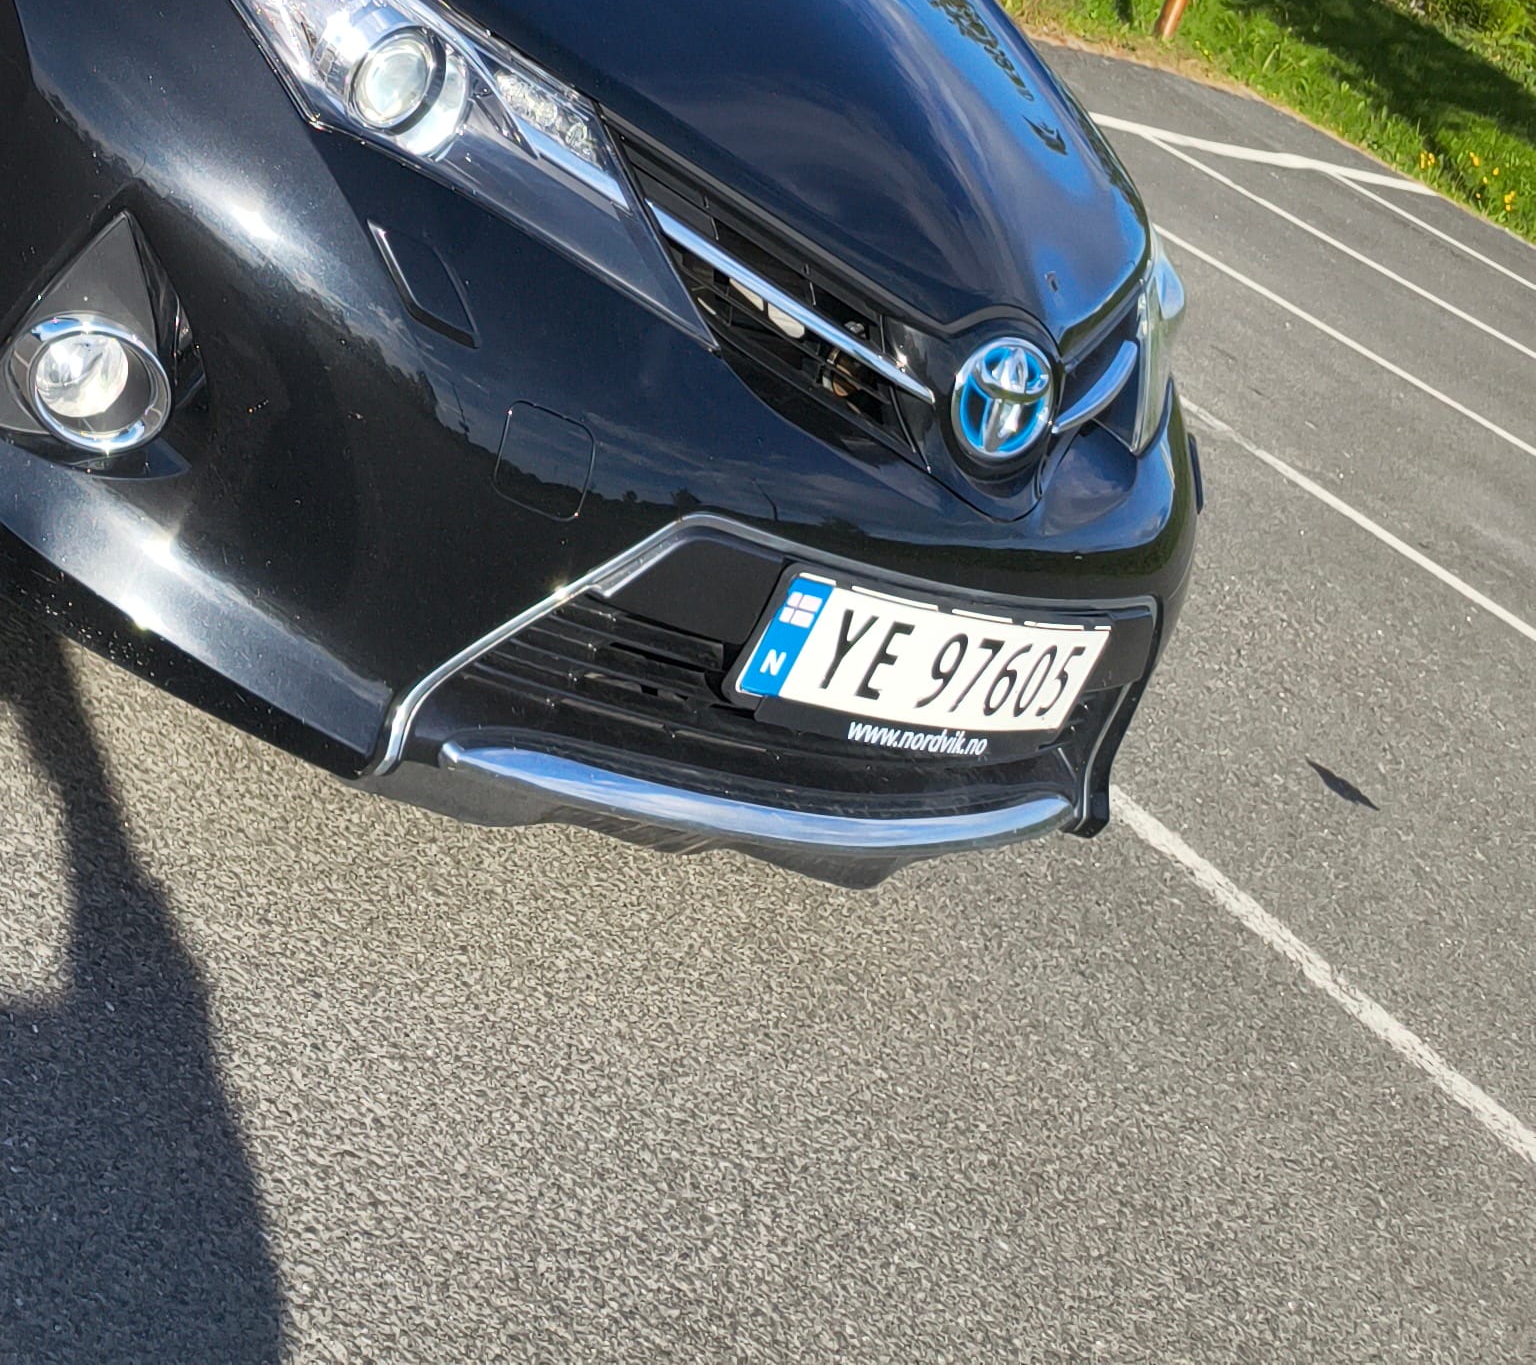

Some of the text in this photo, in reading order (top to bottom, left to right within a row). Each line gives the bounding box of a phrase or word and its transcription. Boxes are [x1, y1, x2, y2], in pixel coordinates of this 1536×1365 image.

[760, 609, 1087, 718] N YE 97605
[847, 720, 988, 757] www.nordvik.no
